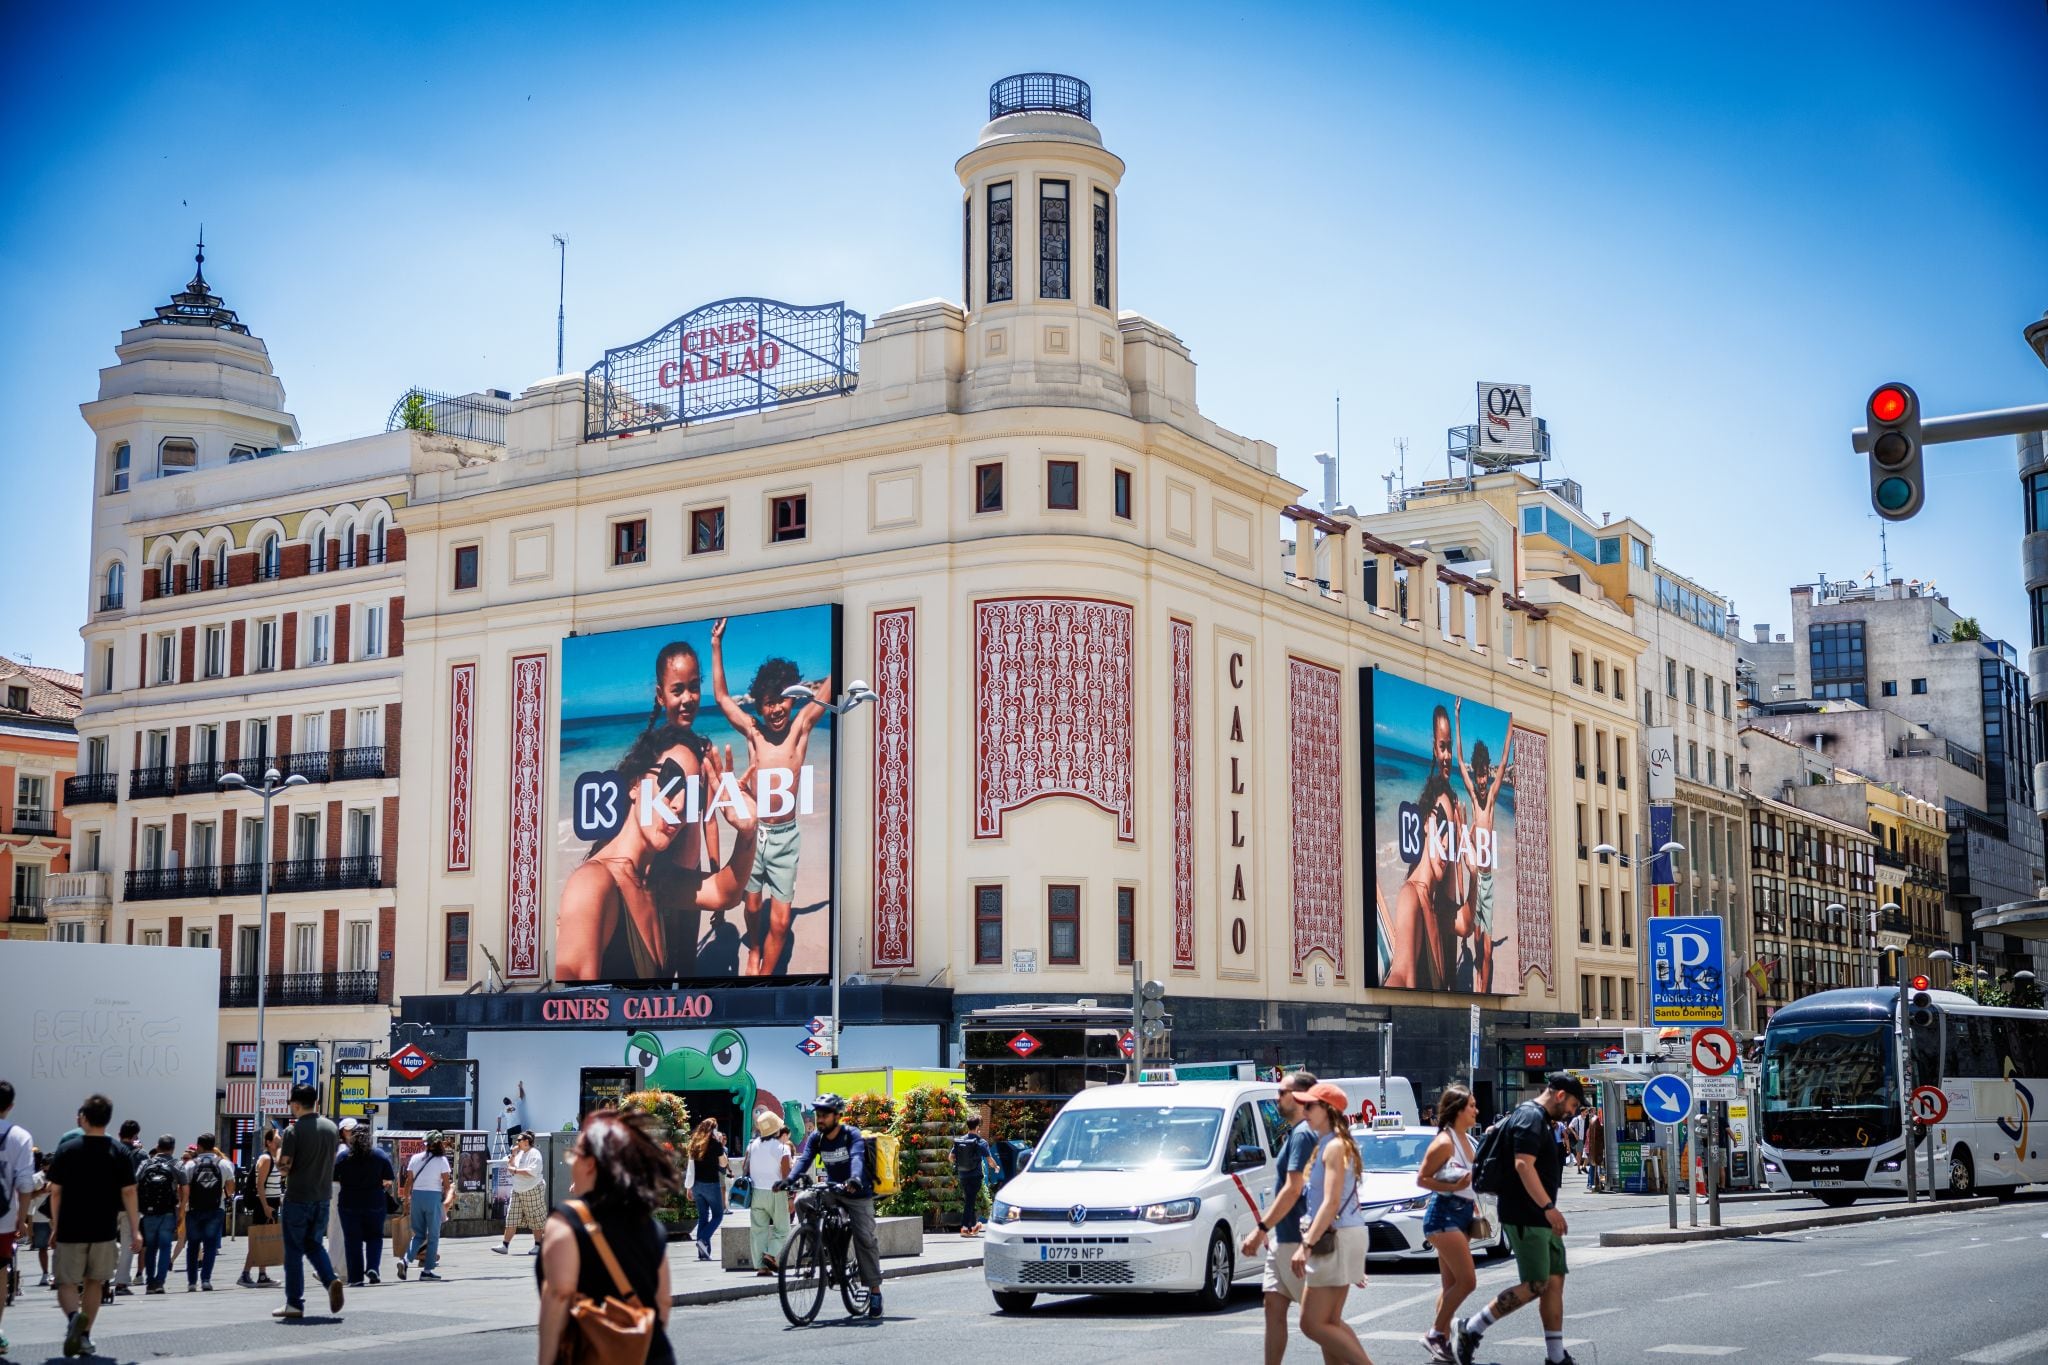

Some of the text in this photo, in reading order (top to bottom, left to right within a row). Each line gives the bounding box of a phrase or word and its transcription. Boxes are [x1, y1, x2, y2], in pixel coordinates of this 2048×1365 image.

[681, 319, 757, 354] CINES
[658, 341, 781, 390] CALLAO
[639, 764, 814, 827] KIABI
[1229, 652, 1247, 956] CALLAO
[1428, 815, 1498, 871] KIABI
[542, 994, 713, 1021] CINES CALLAO
[1655, 1008, 1723, 1018] Santo Domingo
[338, 1047, 366, 1058] CAMBIO
[403, 1058, 423, 1066] Metro
[296, 1064, 309, 1085] P
[1147, 1072, 1163, 1081] TAXI
[1811, 1165, 1840, 1173] MAN
[1049, 1247, 1104, 1260] 0779 NFP
